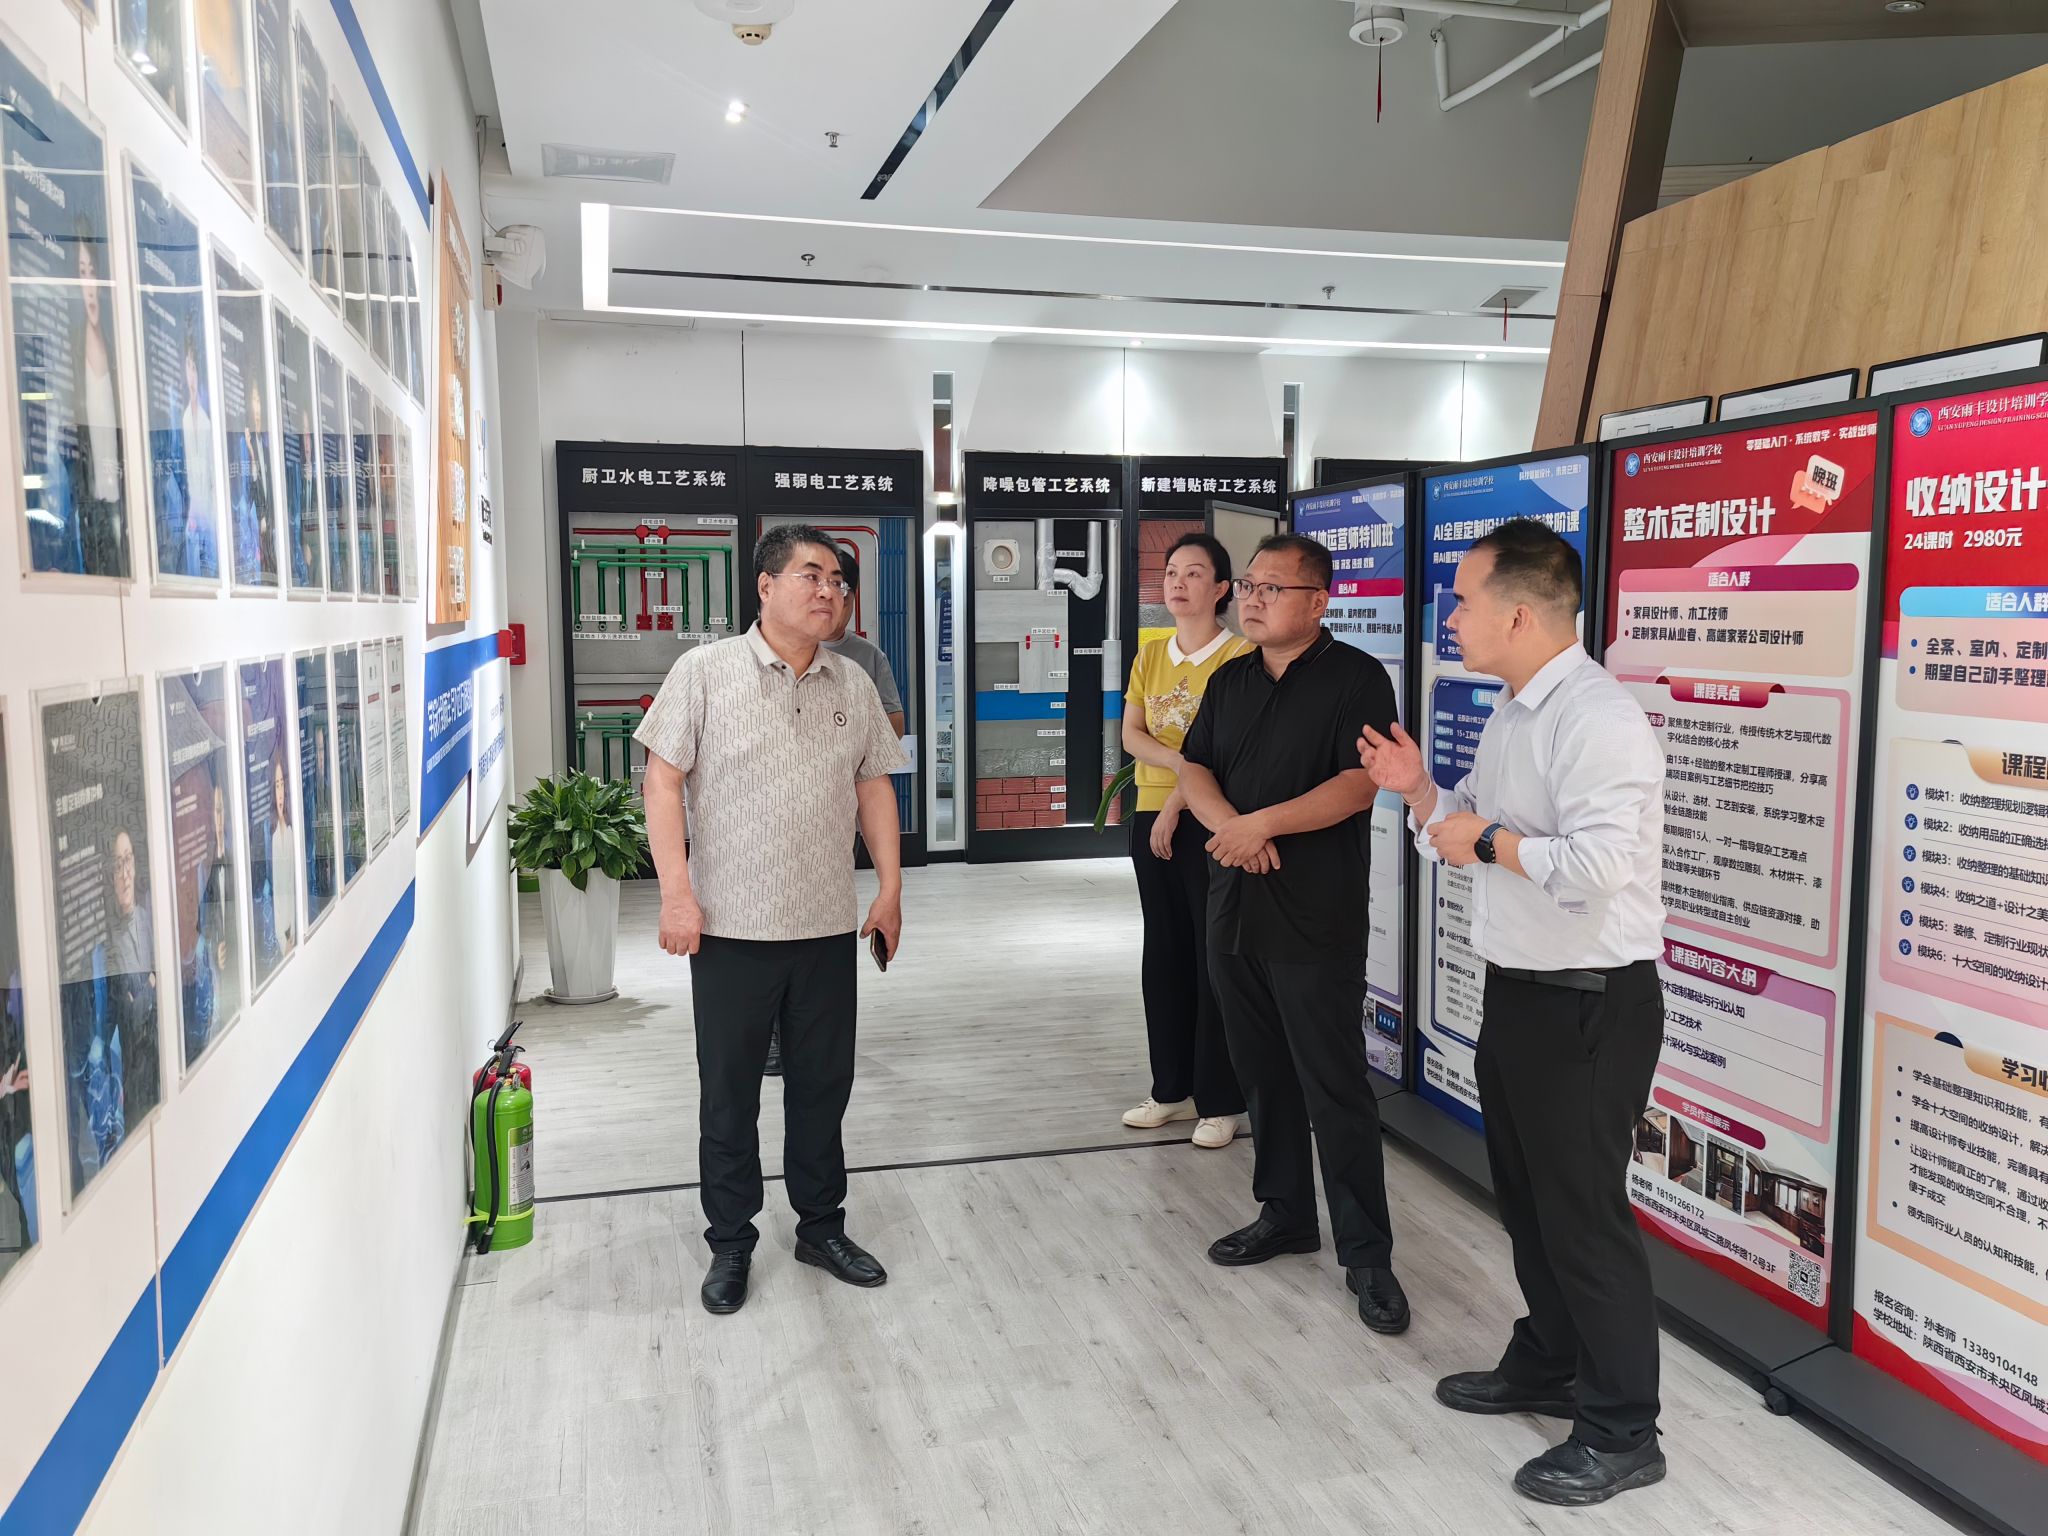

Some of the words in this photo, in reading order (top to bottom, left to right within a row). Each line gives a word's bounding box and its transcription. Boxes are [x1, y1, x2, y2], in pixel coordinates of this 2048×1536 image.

[582, 468, 727, 488] 厨卫水电工艺系统
[774, 472, 894, 492] 强弱电工艺系统
[983, 476, 1110, 494] 降噪包管工艺系统
[1140, 476, 1277, 494] 新建墙贴砖工艺系统
[1812, 465, 1838, 492] 晚班
[1906, 466, 2048, 518] 收纳设计
[1623, 496, 1776, 542] 整木定制设计
[1904, 531, 1954, 550] 24课时
[1964, 528, 2022, 548] 2980元
[1708, 571, 1750, 587] 适合人群
[1633, 606, 1728, 621] 家具设计师、木工技师
[1985, 592, 2048, 612] 适合人群
[1632, 627, 1804, 646] 定制家具从业者、高端家装公司设计师
[1926, 638, 2048, 660] 全案、室内、定制
[1924, 663, 2048, 688] 期望自己动手整理
[1693, 682, 1741, 702] 课程亮点
[1667, 732, 1740, 750] 字化结合的核心技术
[1668, 717, 1832, 745] 聚焦整木定制行业，传授传统木艺与现代数
[1666, 754, 1828, 787] 由15年+经验的整木定制工程师授课，分享高
[2002, 752, 2048, 780] 课程
[1664, 790, 1825, 828] 从设计、选材、工艺到安装，系统学习整木定
[1924, 787, 2048, 818] 模块1：收纳整理规划逻辑
[1920, 881, 2048, 922] 模块4：收纳之道+设计之美
[1671, 945, 1757, 988] 课程内容大纲
[1682, 1101, 1730, 1132] 学员作品展示
[1656, 1186, 1705, 1220] 18191266172
[1908, 1180, 1946, 1206] 便于成交
[1907, 1204, 2048, 1282] 领先同行业人员的认知和技能，
[1874, 1288, 1956, 1344] 报名咨询：孙老师
[1962, 1336, 2038, 1387] 13389104148
[1872, 1307, 2048, 1416] 学校地址：陕西省西安市未央区凤城
